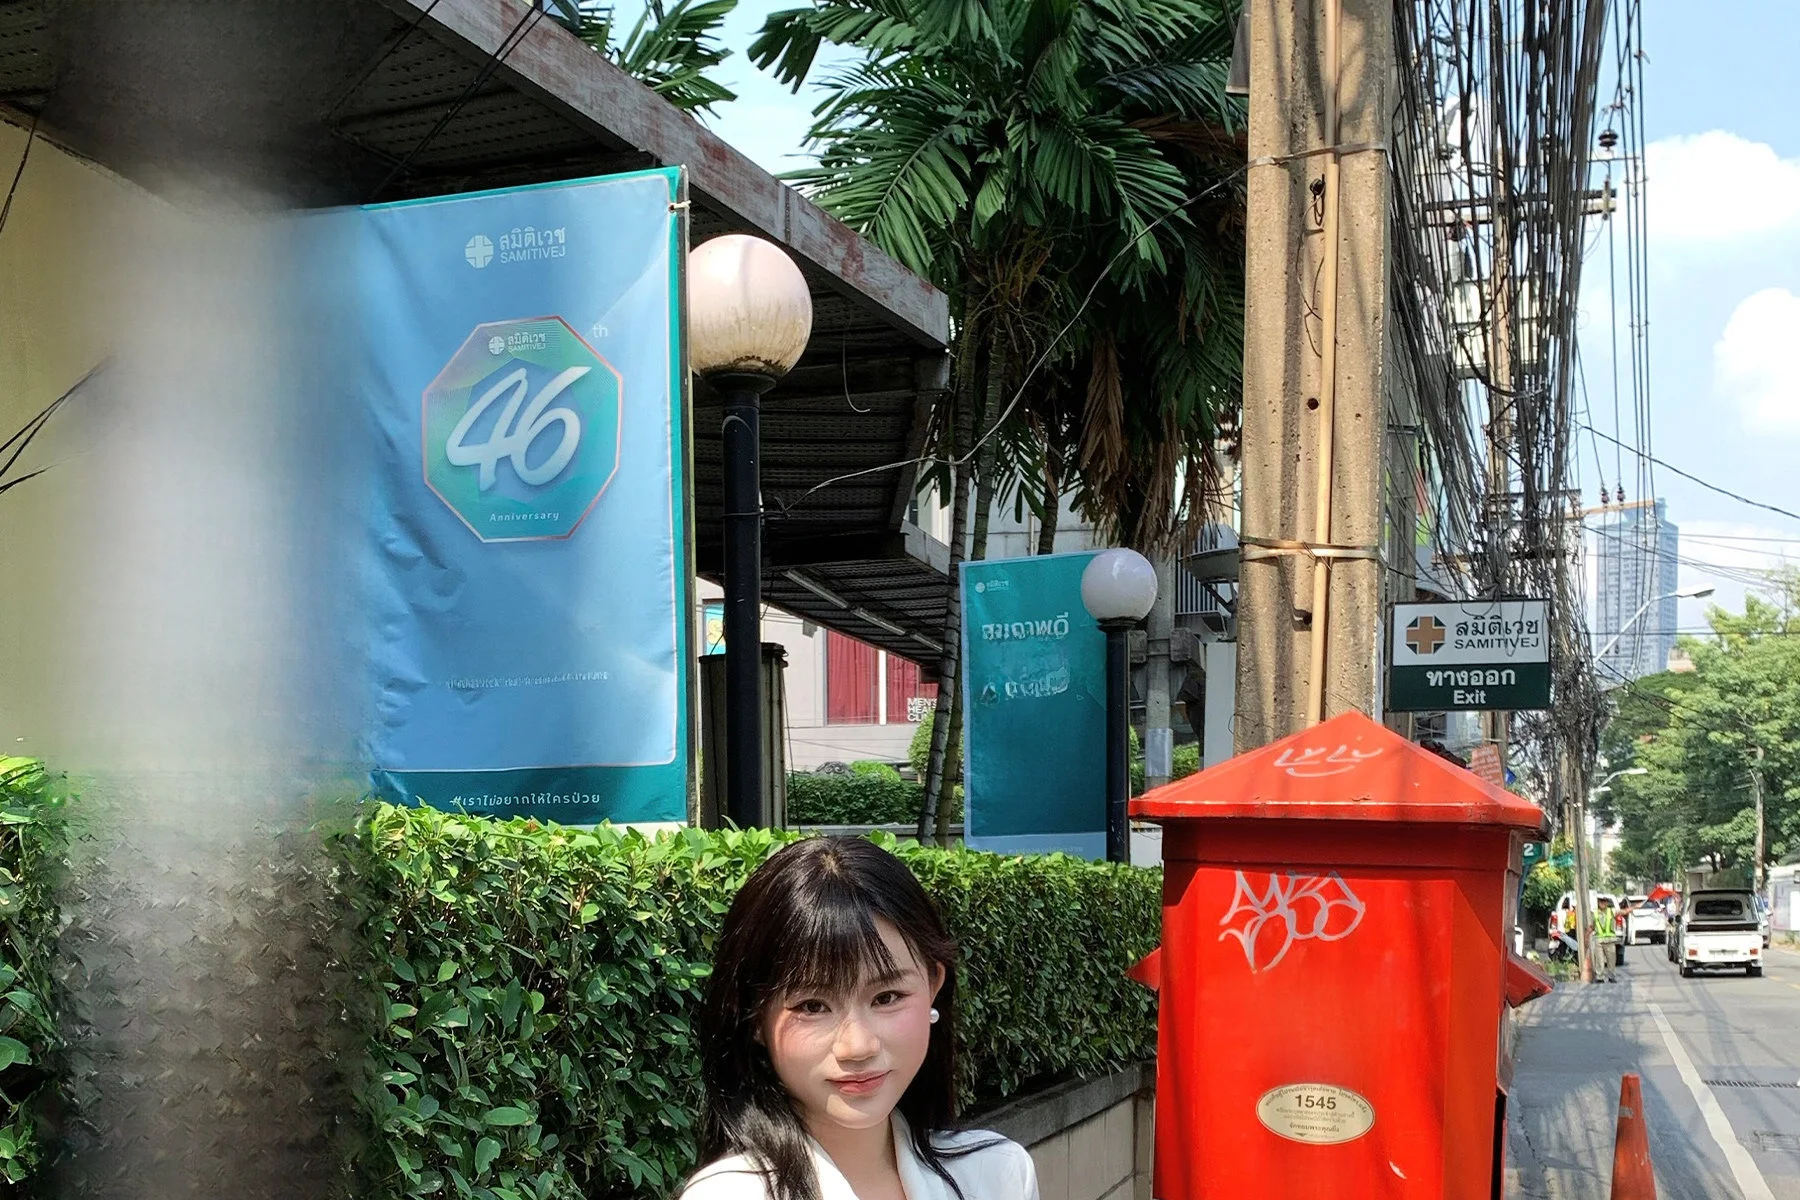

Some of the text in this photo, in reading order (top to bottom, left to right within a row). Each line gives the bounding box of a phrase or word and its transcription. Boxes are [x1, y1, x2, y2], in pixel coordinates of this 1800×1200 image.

[499, 226, 566, 250] สมิติเวช
[500, 245, 566, 264] SAMITIVEJ
[592, 323, 609, 338] th
[446, 366, 592, 492] 46
[489, 512, 559, 523] Anniversary
[1455, 615, 1539, 637] สมิติเวช
[1454, 637, 1539, 650] SAMITIVEJ
[1426, 668, 1516, 687] ทางออก
[1453, 689, 1487, 705] Exit
[1295, 1094, 1337, 1111] 1545
